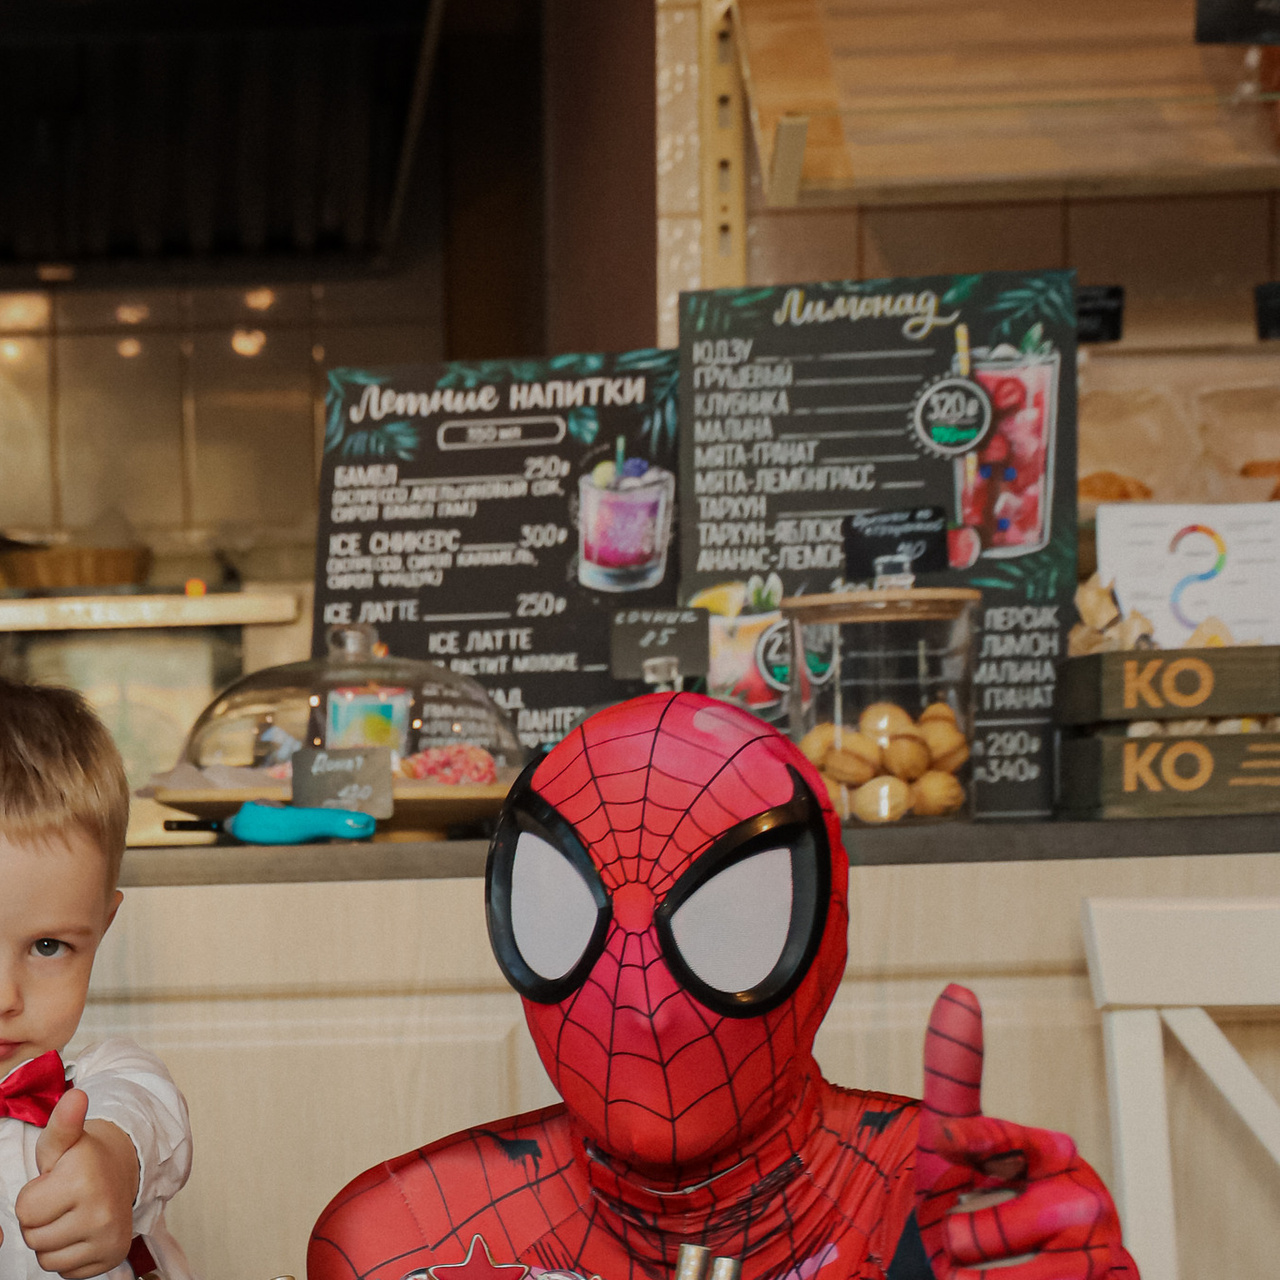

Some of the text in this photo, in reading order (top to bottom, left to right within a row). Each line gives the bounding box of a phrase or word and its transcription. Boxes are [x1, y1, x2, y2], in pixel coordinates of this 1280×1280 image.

[773, 288, 961, 340] Лимонад
[349, 376, 646, 424] Летние НАПИТКИ
[698, 495, 767, 519] ТАРХУН
[698, 518, 844, 546] ТАРХУН-ЯБЛОК
[323, 602, 353, 624] ICE
[358, 599, 419, 623] ЛАТТЕ
[428, 626, 534, 654] ICE ЛАТТЕ
